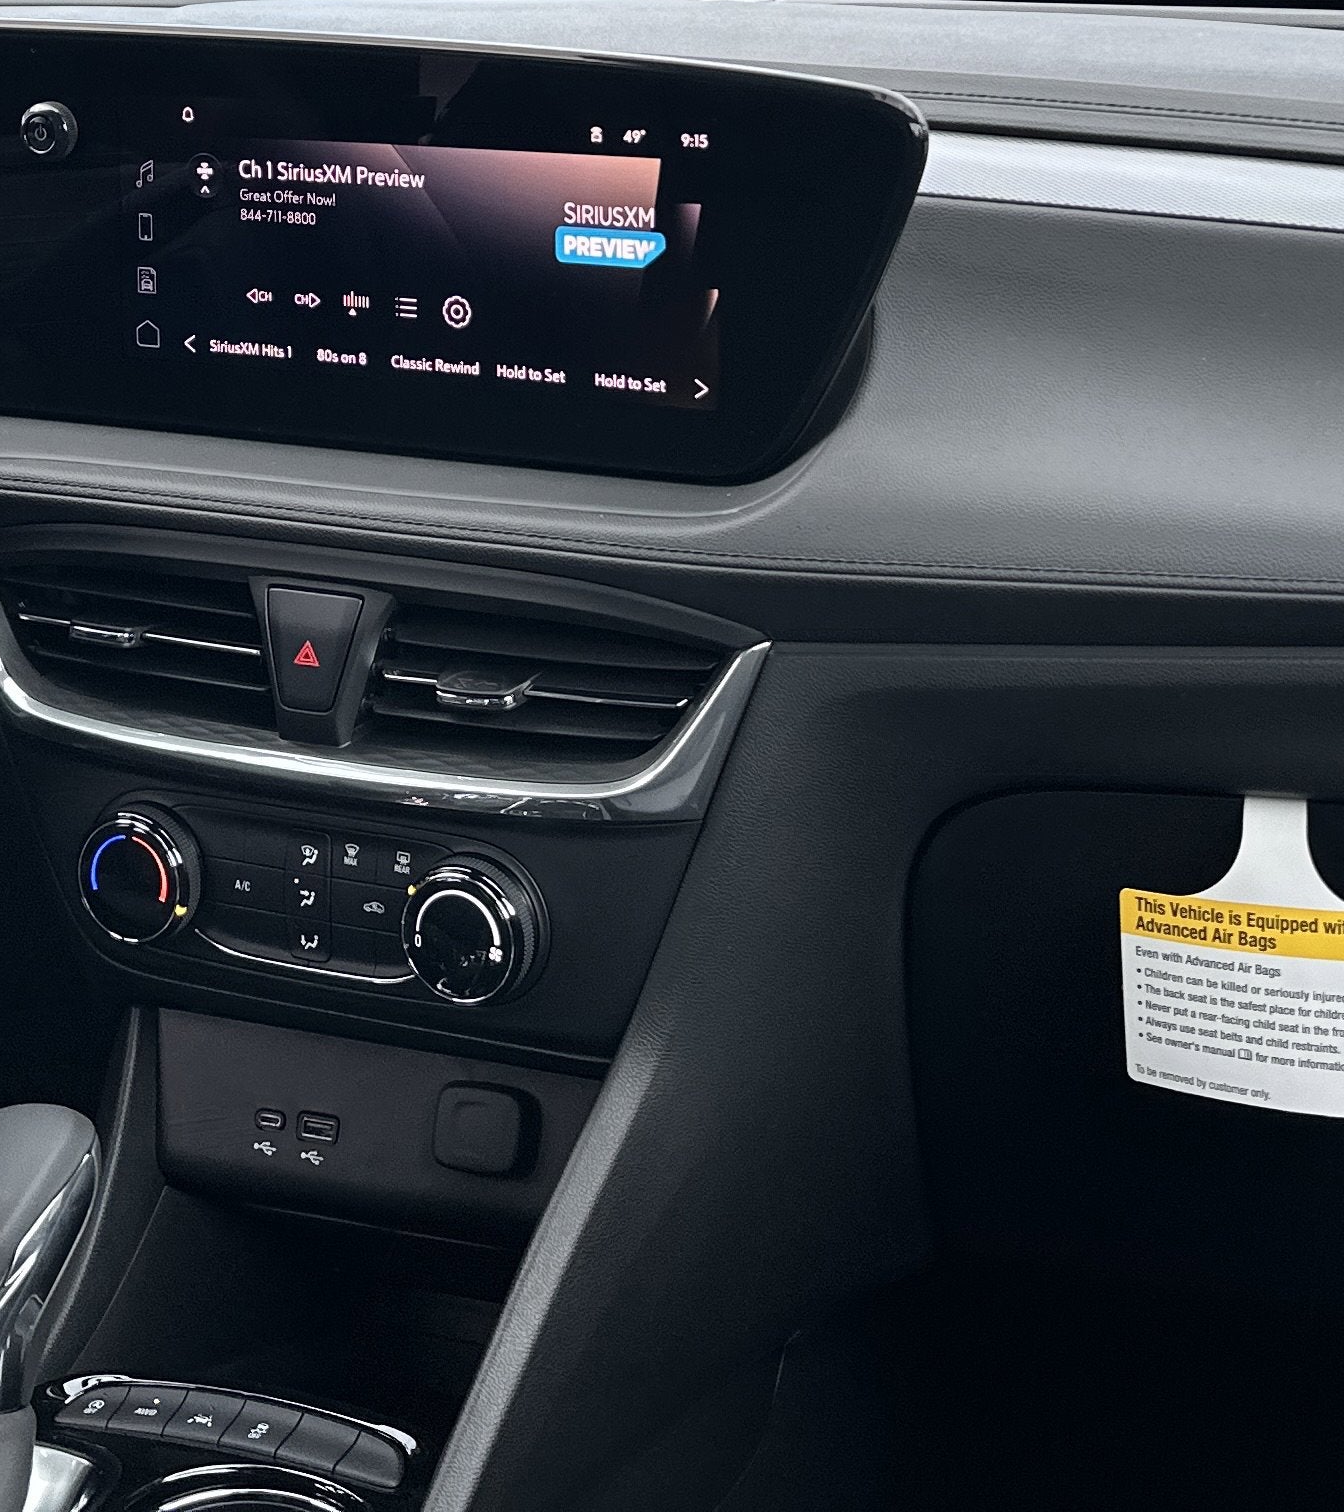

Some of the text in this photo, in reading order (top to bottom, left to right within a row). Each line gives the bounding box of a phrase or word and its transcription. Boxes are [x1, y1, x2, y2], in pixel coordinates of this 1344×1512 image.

[680, 133, 709, 149] 9:15
[238, 159, 425, 188] Ch 1 SiriusXM Preview
[239, 188, 336, 207] Great Offer Now!
[240, 208, 316, 225] 844-711-8800
[563, 201, 655, 229] SIRIUSXM
[563, 235, 656, 261] PREVIEW
[209, 339, 293, 359] SiriusXM Hits 1
[316, 349, 367, 366] 80s on 8
[391, 355, 480, 376] Classic Rewind
[496, 364, 566, 383] Hold to Set
[594, 372, 667, 394] Hold to Set
[235, 880, 251, 892] A/C
[1135, 896, 1166, 915] This
[1169, 902, 1224, 923] Vehicle
[1228, 910, 1242, 926] is
[1247, 912, 1318, 934] Equipped
[1136, 916, 1277, 951] Advanced Air Bags
[1136, 946, 1281, 978] Even with Advanced Air Bags
[1144, 968, 1183, 983] Children
[1186, 976, 1203, 986] can
[1206, 978, 1218, 989] be
[1221, 980, 1248, 993] killed
[1251, 986, 1261, 995] or
[1264, 988, 1309, 1002] seriously
[1144, 984, 1161, 995] The
[1163, 988, 1185, 1000] back
[1187, 993, 1207, 1004] seat
[1210, 995, 1217, 1005] is
[1220, 997, 1235, 1008] the
[1238, 1001, 1266, 1012] safest
[1269, 1005, 1295, 1015] place
[1298, 1007, 1311, 1017] for
[1145, 1000, 1171, 1013] Never
[1173, 1007, 1188, 1017] put
[1191, 1010, 1196, 1018] a
[1199, 1011, 1250, 1028] rear-facing
[1253, 1019, 1276, 1030] child
[1279, 1023, 1299, 1034] seat
[1302, 1024, 1310, 1034] in
[1313, 1025, 1329, 1036] the
[1146, 1016, 1341, 1054] Always use seat belts and child restraints.
[1146, 1032, 1162, 1044] See
[1165, 1038, 1200, 1051] owner's
[1202, 1045, 1235, 1058] manual
[1256, 1052, 1269, 1063] for
[1271, 1057, 1295, 1067] more
[1136, 1063, 1271, 1101] To be removed by customer only.
